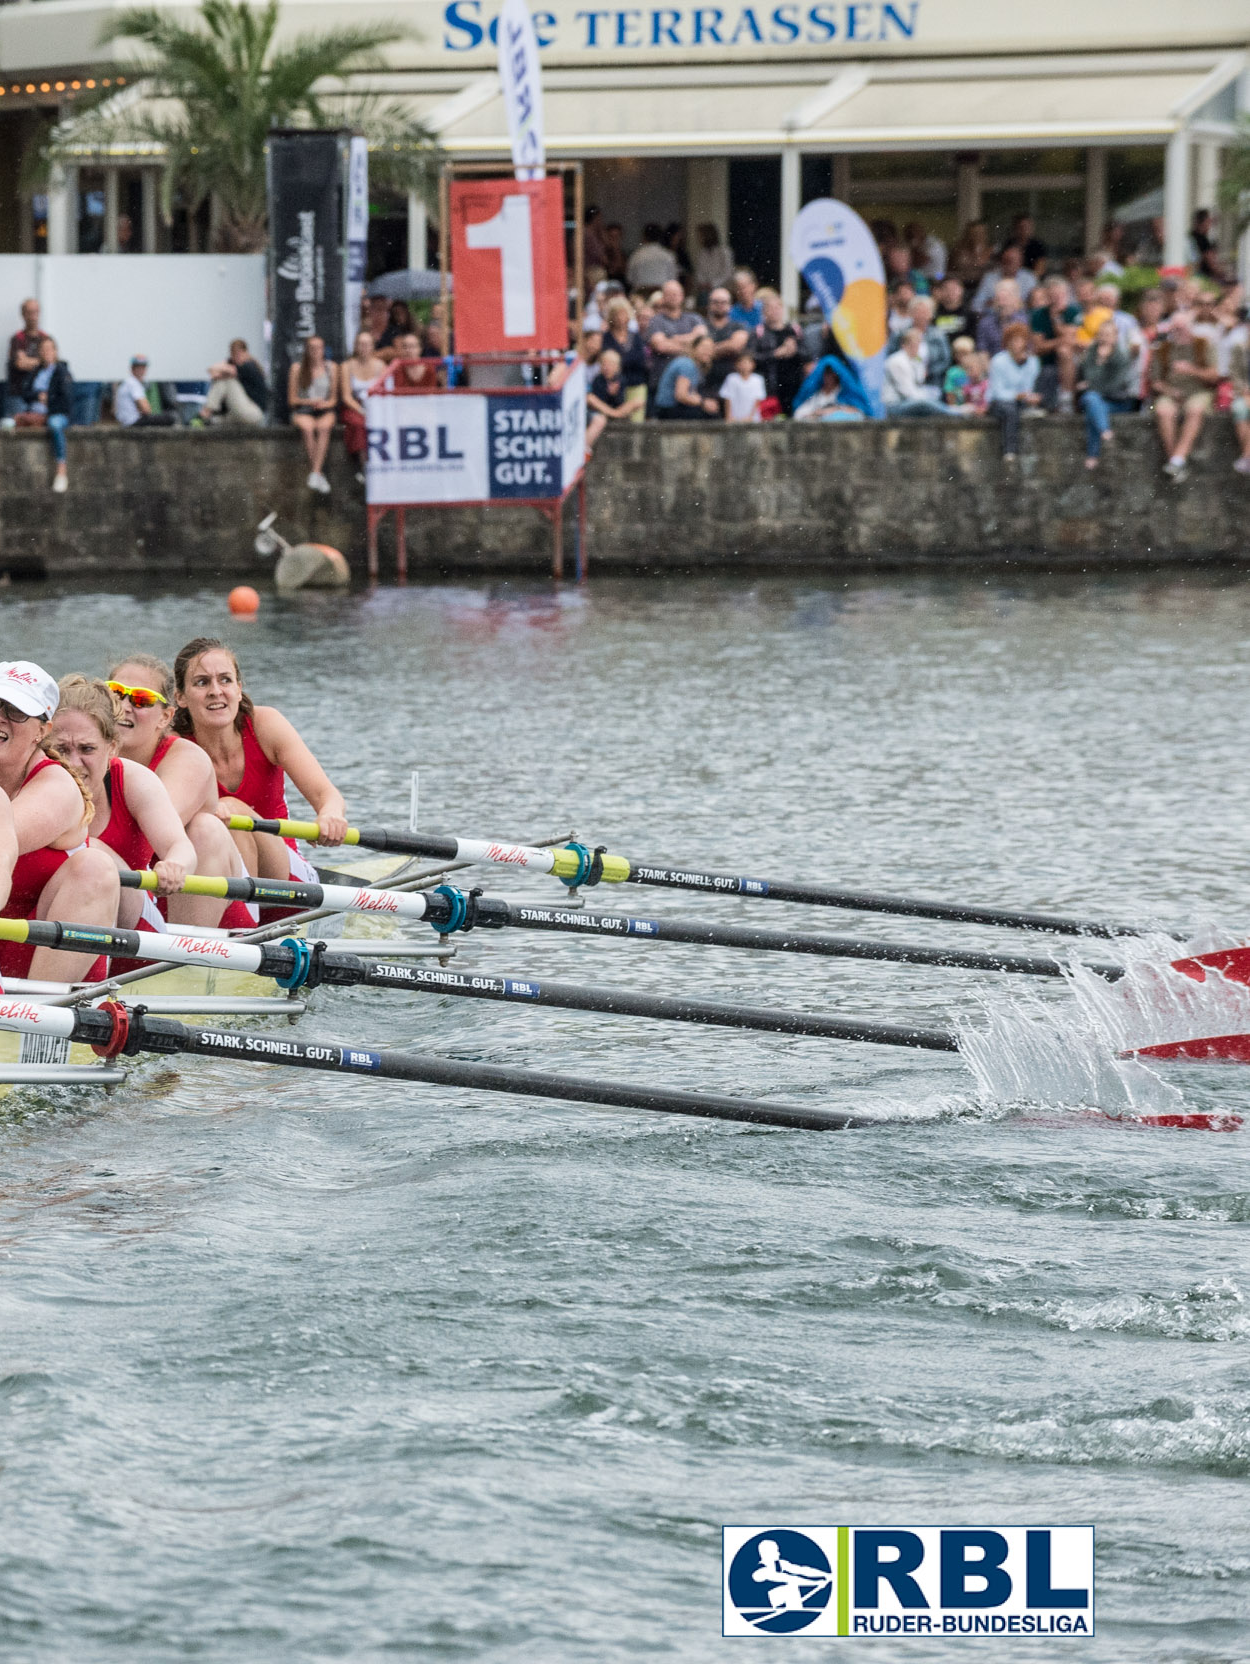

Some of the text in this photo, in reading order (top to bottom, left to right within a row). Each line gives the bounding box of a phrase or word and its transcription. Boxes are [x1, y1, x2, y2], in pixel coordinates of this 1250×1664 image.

[576, 1, 920, 48] TERRASSEN
[466, 194, 536, 337] 1
[494, 461, 553, 485] GUT.
[520, 909, 623, 930] STARK. SCHNELL. GUT.
[376, 964, 497, 991] STARK. SCHNELL. GUT.
[511, 981, 533, 993] RBL
[201, 1031, 335, 1062] STARK. SCHNELL. GUT.
[349, 1051, 374, 1065] RBL
